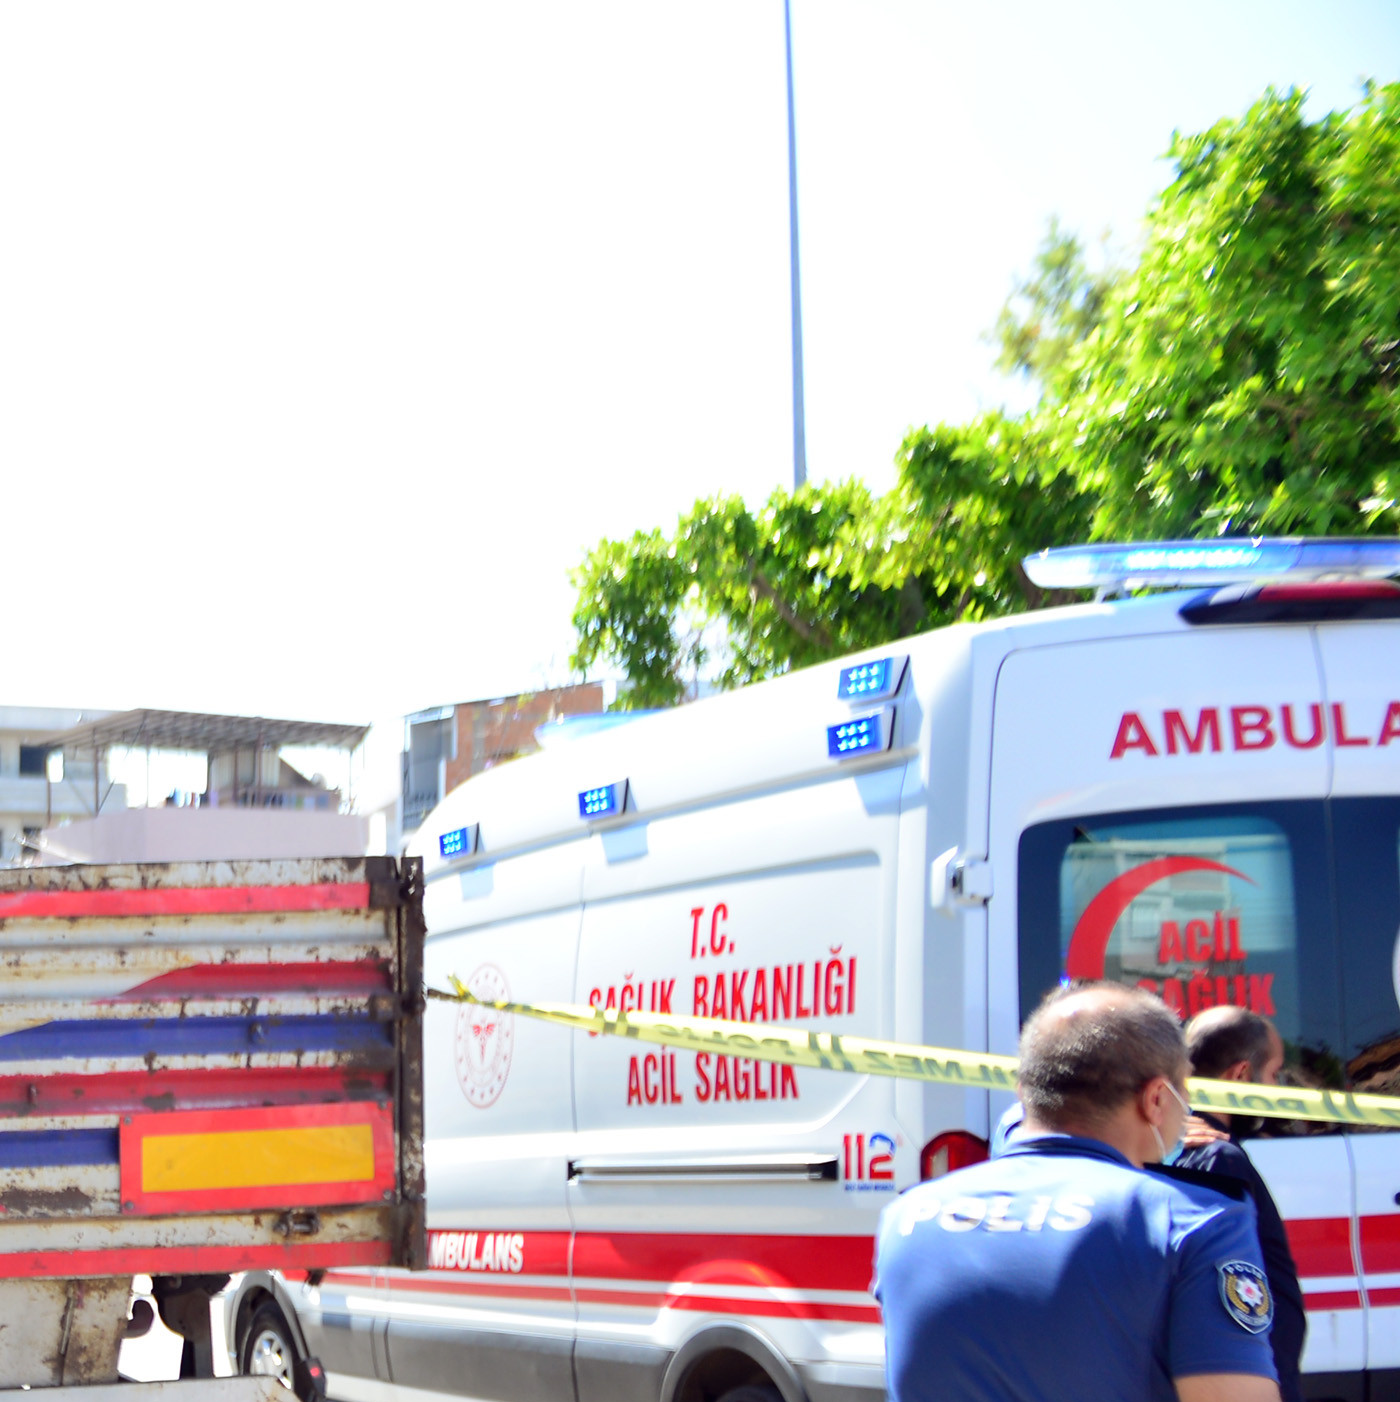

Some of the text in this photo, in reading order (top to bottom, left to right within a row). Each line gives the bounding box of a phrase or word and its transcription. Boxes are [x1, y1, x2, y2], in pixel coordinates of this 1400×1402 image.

[690, 902, 735, 959] T.C.
[1157, 910, 1248, 964] ACİL
[627, 1044, 683, 1106] ACİL
[843, 1131, 896, 1180] 112
[429, 1231, 524, 1274] MBULANS
